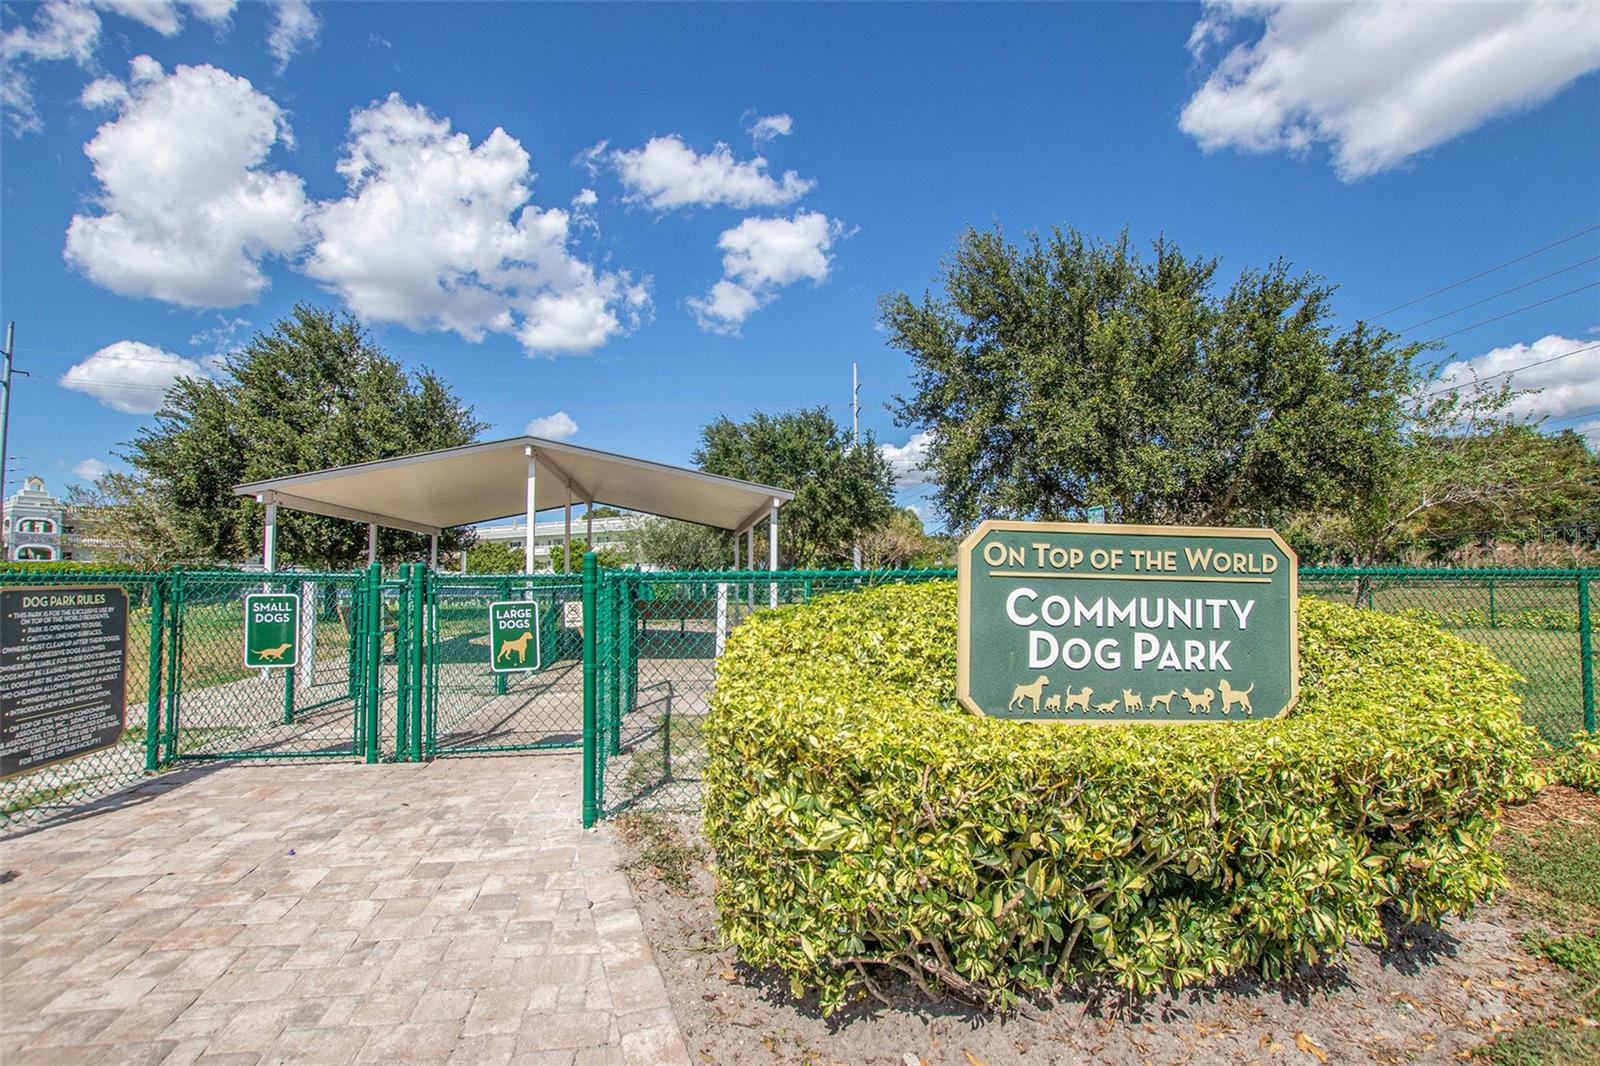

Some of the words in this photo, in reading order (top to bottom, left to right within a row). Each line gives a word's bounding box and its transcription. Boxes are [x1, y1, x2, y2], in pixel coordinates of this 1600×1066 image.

[983, 541, 1025, 567] ON
[1032, 543, 1084, 568] TOP
[1090, 549, 1123, 570] OF
[1130, 550, 1177, 571] THE
[1184, 547, 1278, 573] WORLD
[23, 597, 49, 607] DOG
[50, 596, 76, 606] PARK
[78, 595, 106, 605] RULES
[252, 602, 292, 612] SMALL
[1006, 587, 1255, 629] COMMUNITY
[496, 608, 532, 618] LARGE
[256, 614, 290, 623] DOGS
[499, 620, 530, 629] DOGS
[1029, 630, 1121, 670] DOG
[1133, 632, 1232, 671] PARK
[11, 680, 28, 689] DOGS
